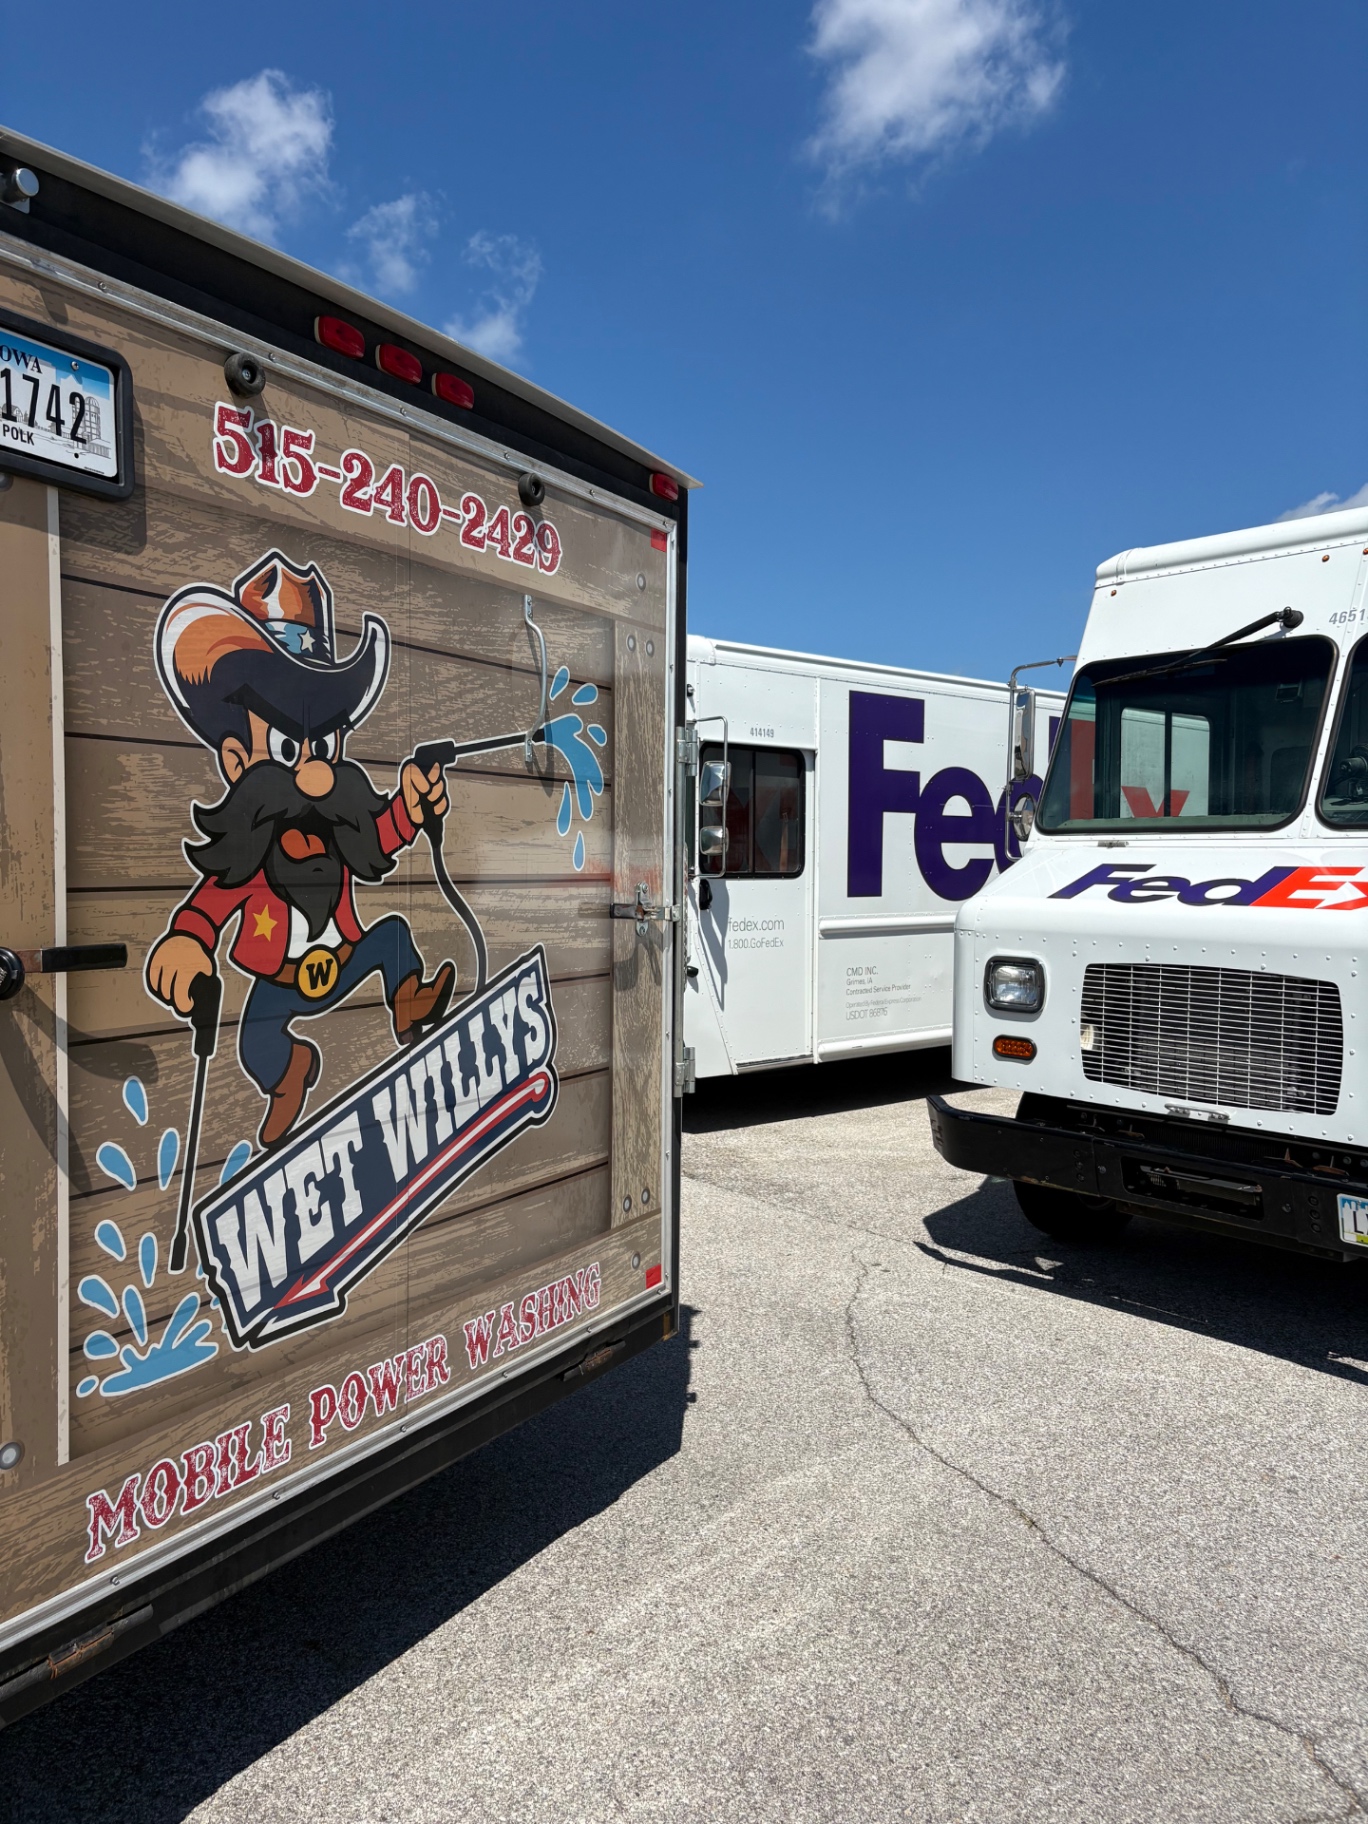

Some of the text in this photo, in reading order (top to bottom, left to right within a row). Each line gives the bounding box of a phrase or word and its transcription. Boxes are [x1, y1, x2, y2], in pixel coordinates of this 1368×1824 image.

[3, 424, 34, 446] POLK
[214, 402, 562, 574] 515-240-2429
[1328, 609, 1368, 625] 4651
[750, 727, 774, 738] 414149
[728, 917, 785, 931] fedex.com
[728, 937, 784, 949] 1.800.GoFedEx
[305, 958, 334, 990] W
[846, 965, 879, 976] CMD INC.
[845, 983, 911, 996] Contracted Service Provider
[845, 1009, 868, 1021] USDOT
[216, 971, 547, 1312] WET WILLYS
[85, 1262, 602, 1563] MOBILE POWER WASHING
